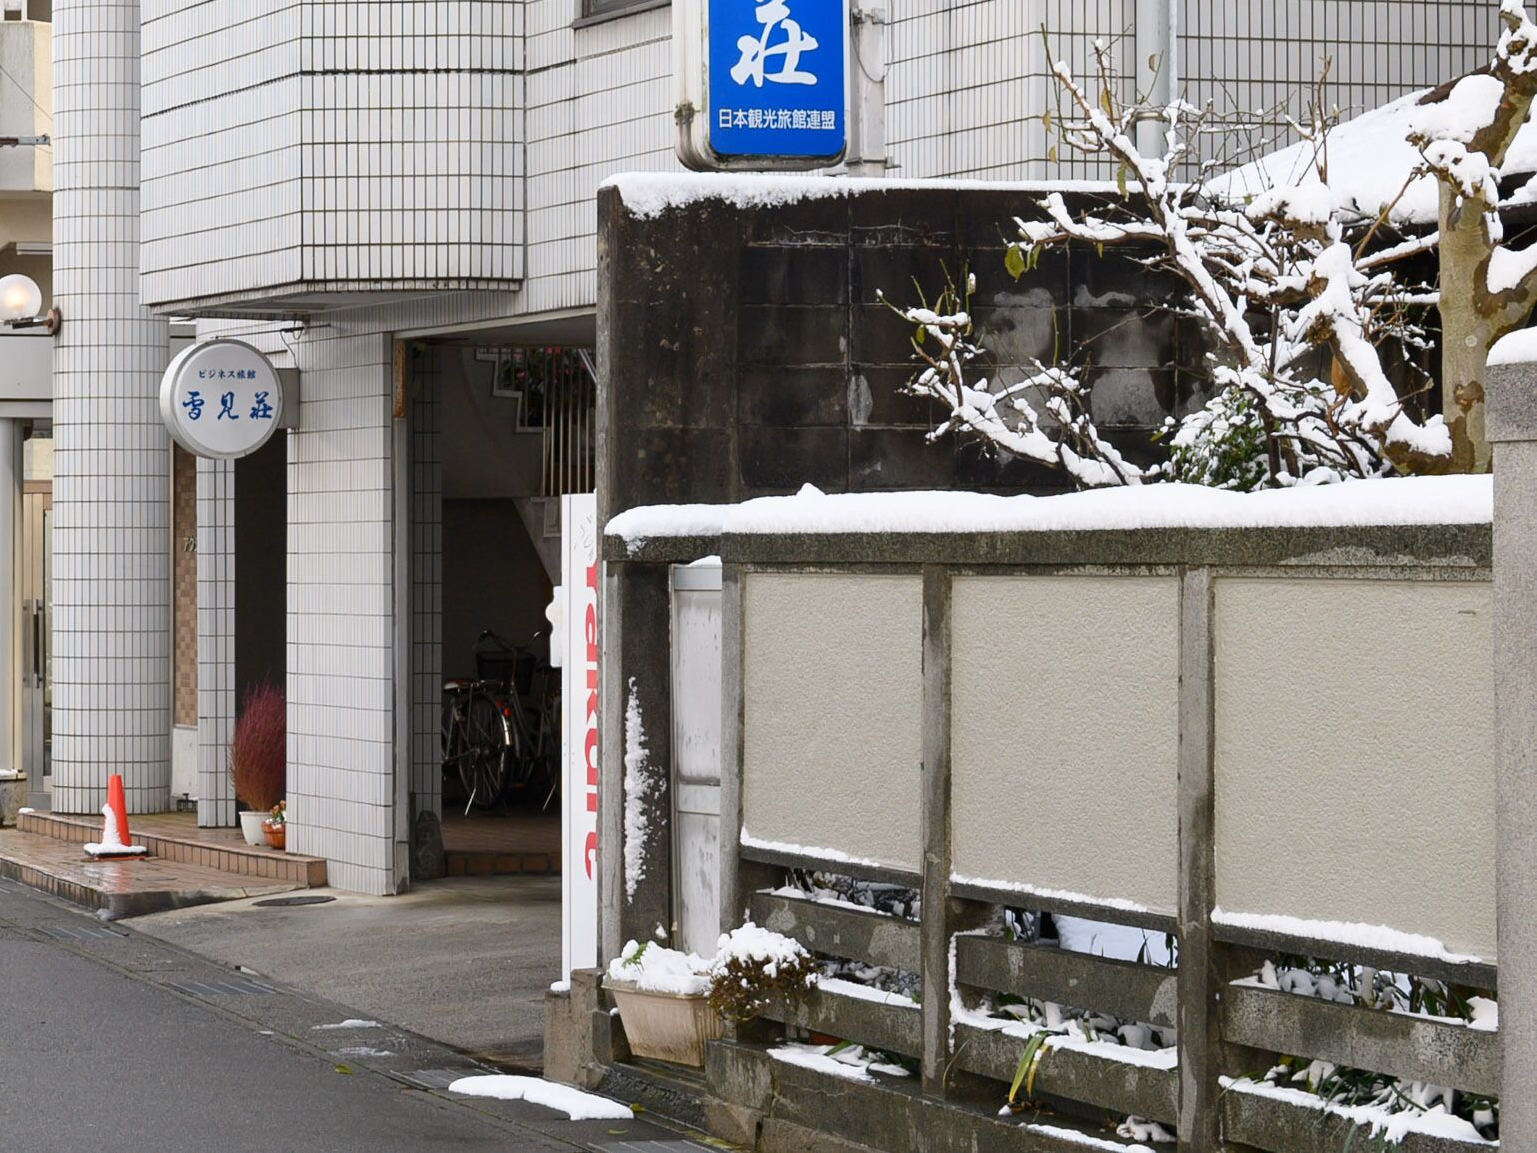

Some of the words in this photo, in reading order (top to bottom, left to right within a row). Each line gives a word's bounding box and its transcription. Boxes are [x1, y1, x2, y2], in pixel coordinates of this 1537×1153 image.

[719, 108, 836, 130] 日本観光旅館連盟
[199, 369, 256, 379] ビジネス旅館
[182, 390, 273, 421] 雪見荘
